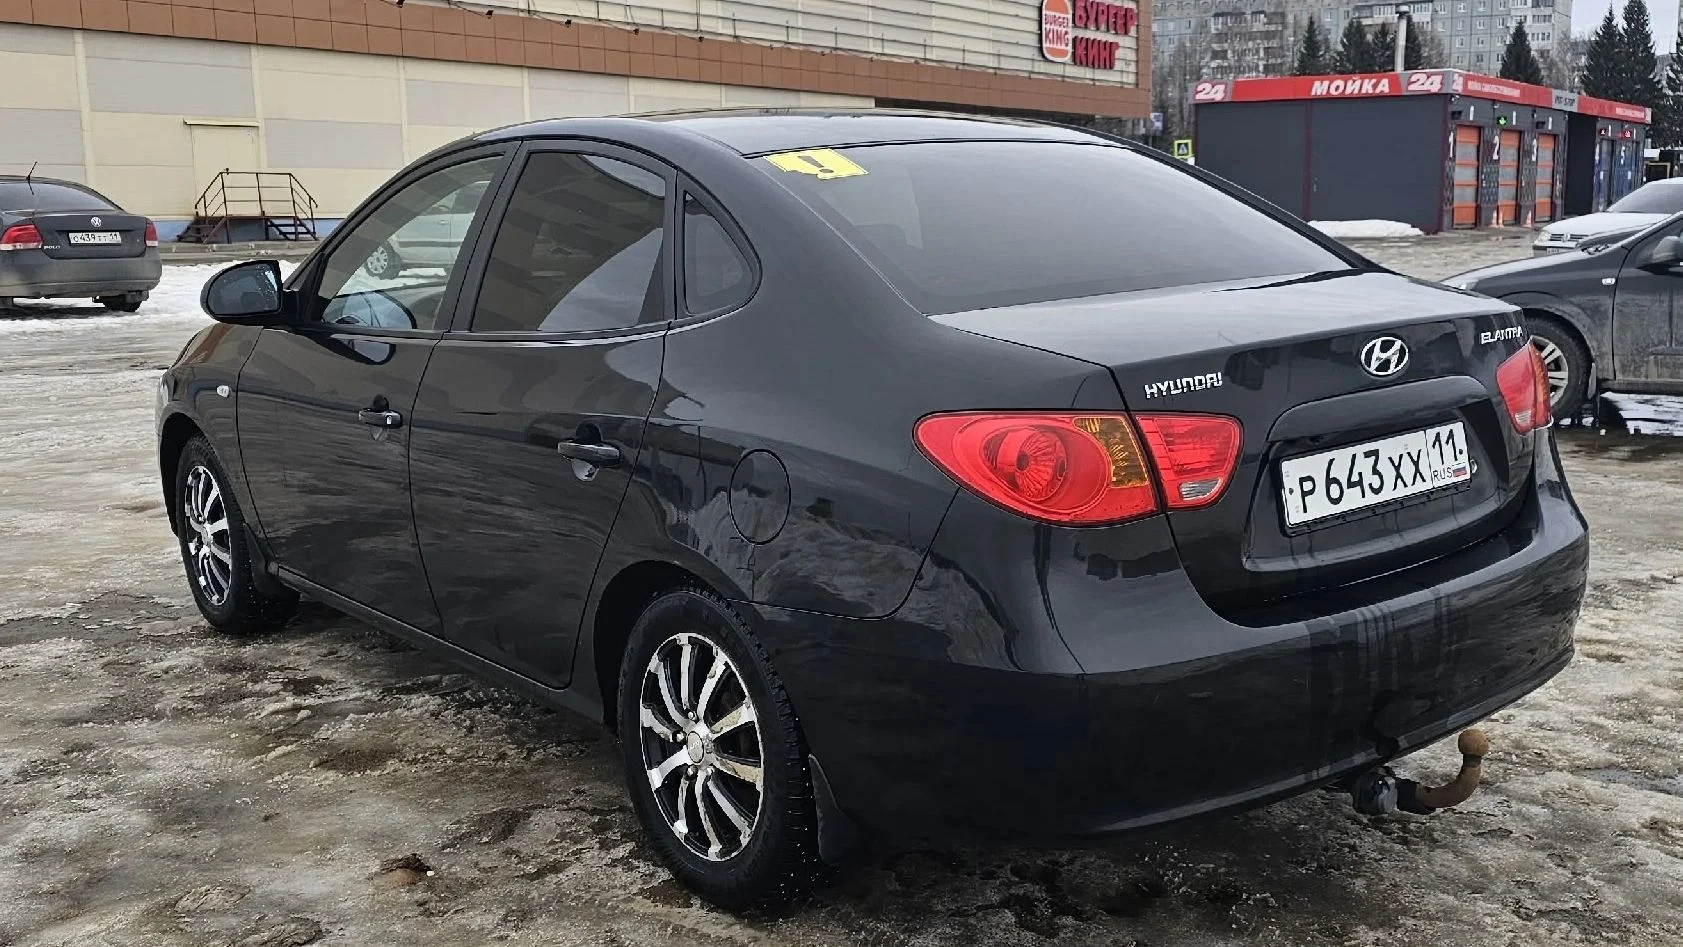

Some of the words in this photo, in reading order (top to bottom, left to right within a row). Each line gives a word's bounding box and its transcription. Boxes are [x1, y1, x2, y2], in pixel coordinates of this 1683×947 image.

[1074, 0, 1137, 35] БУРГЕР
[1044, 27, 1069, 47] KING
[1074, 35, 1120, 70] КИНГ
[1195, 82, 1226, 100] 24
[1310, 77, 1390, 96] МОЙКА
[1407, 73, 1442, 93] 24
[1493, 135, 1500, 160] 2
[1481, 325, 1523, 344] ELANTRA
[1144, 371, 1223, 398] HYUNDAI
[1432, 467, 1453, 481] RUS
